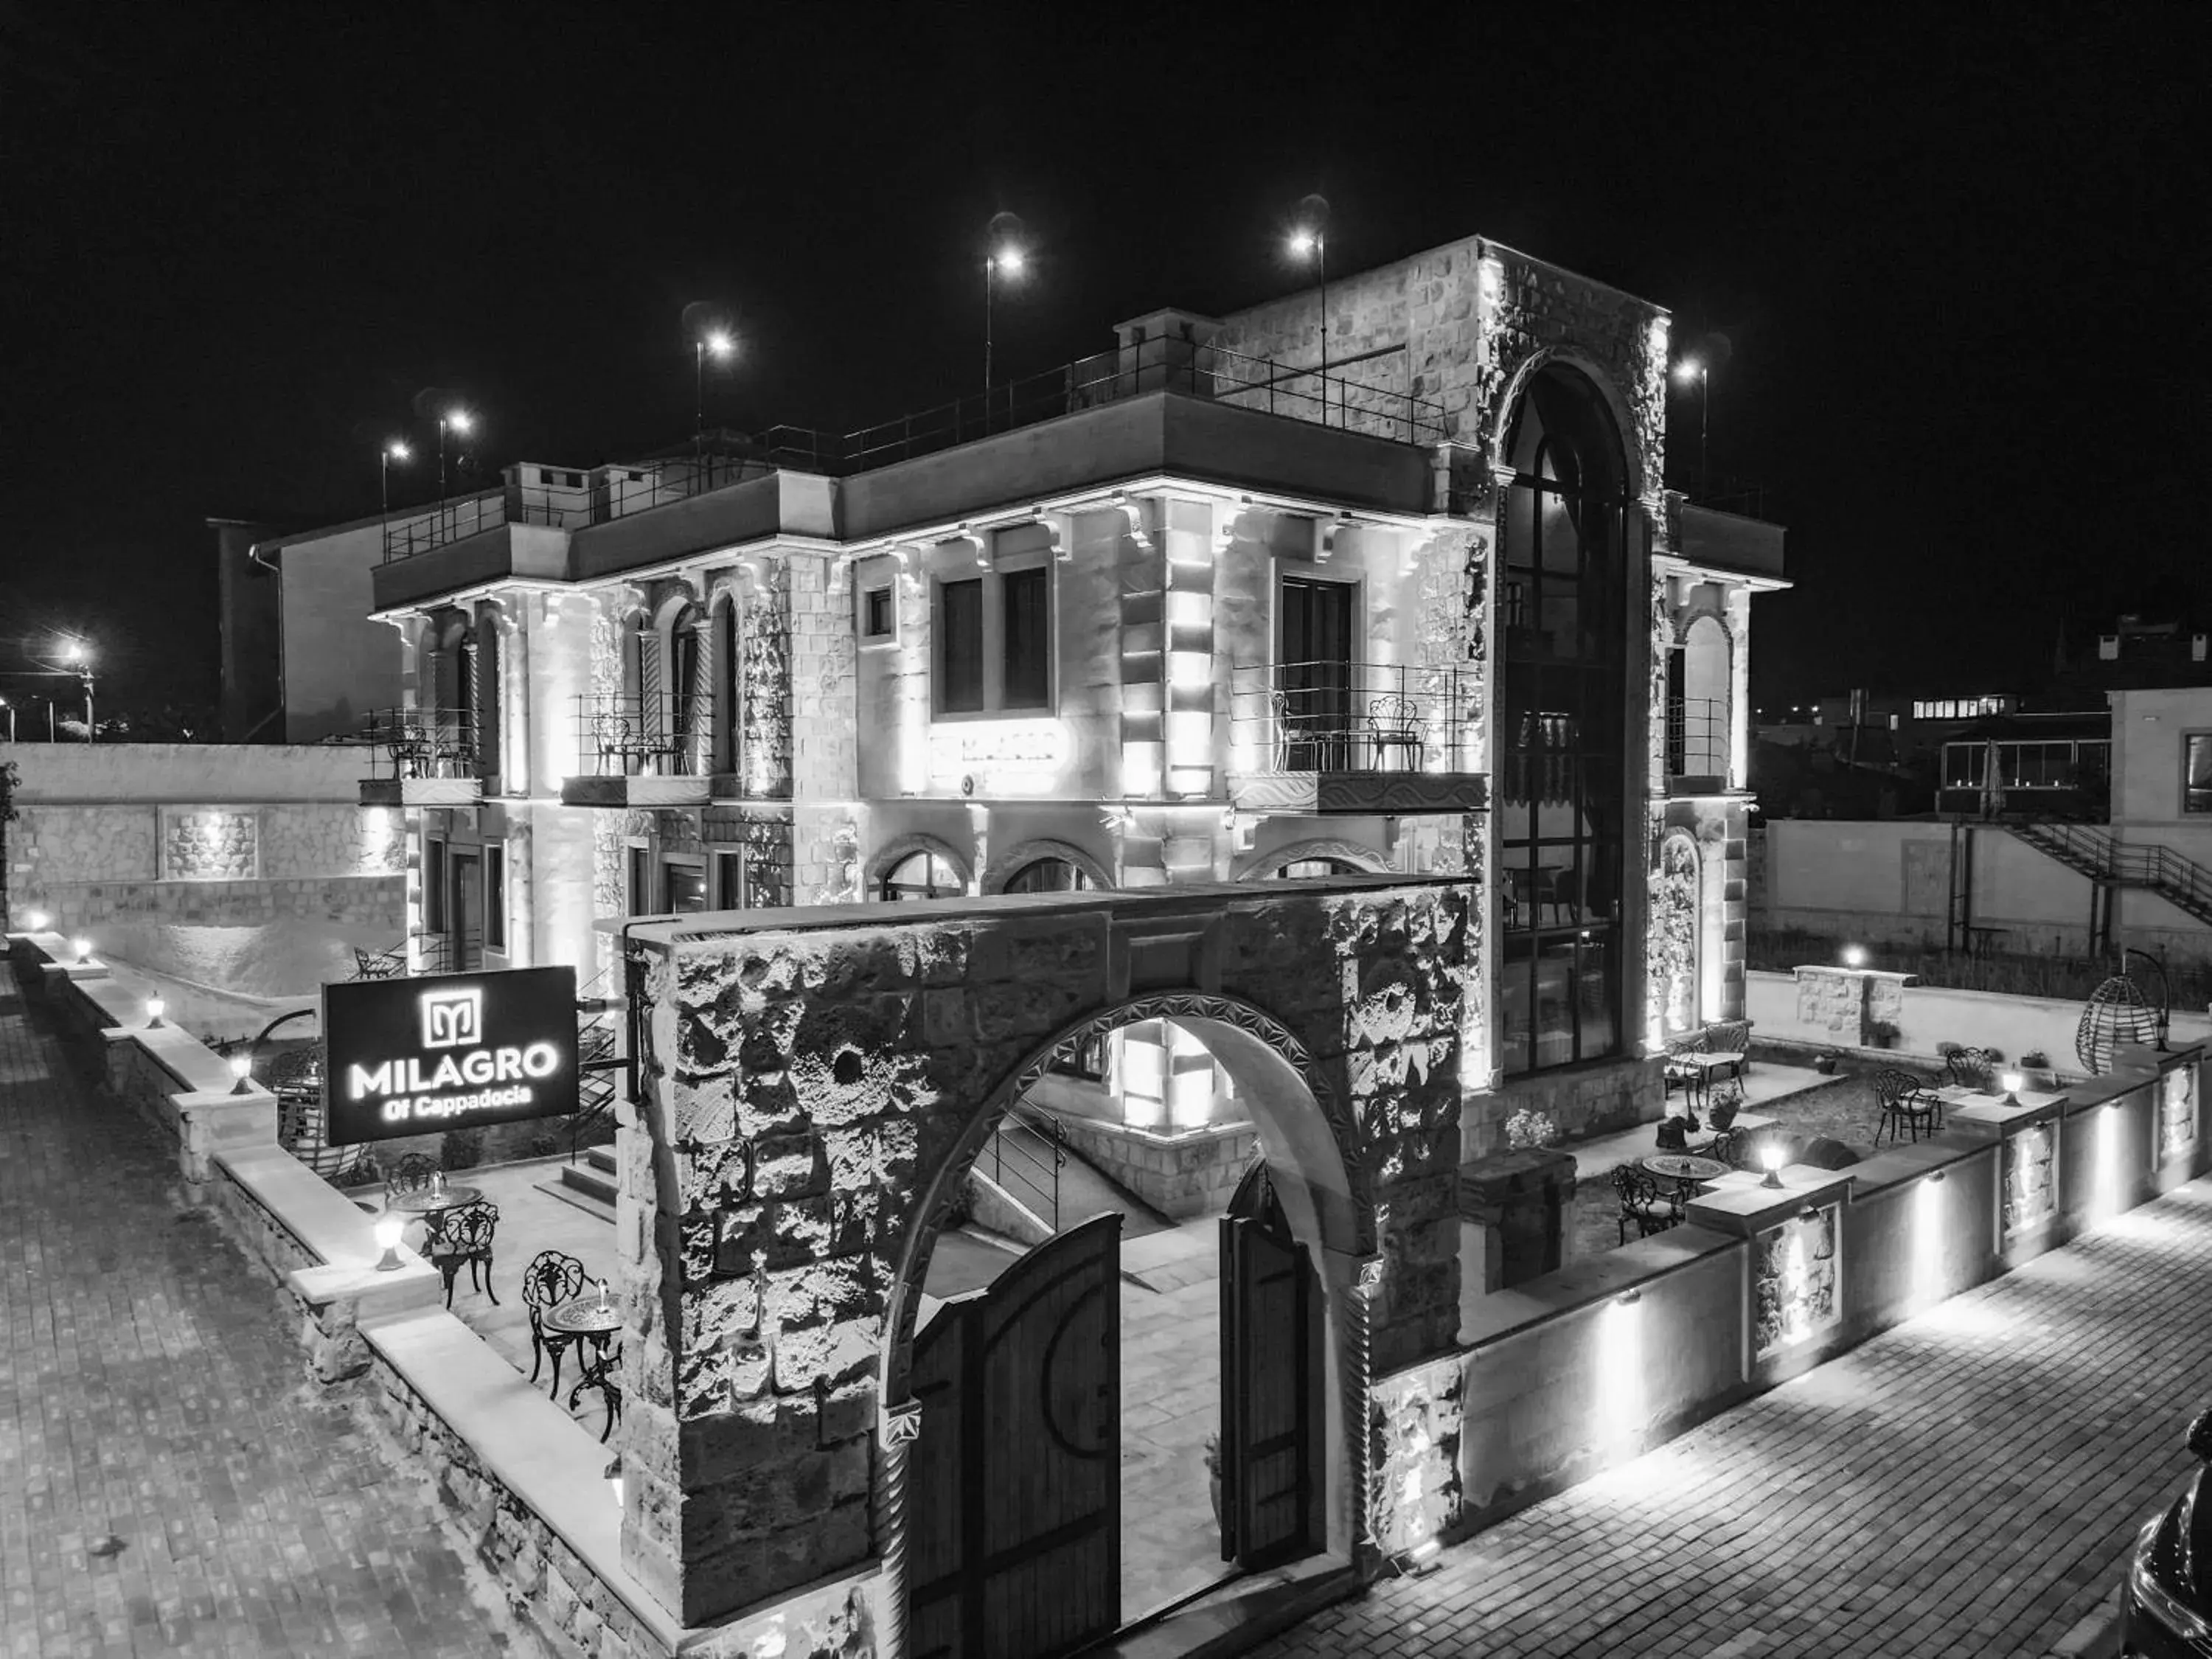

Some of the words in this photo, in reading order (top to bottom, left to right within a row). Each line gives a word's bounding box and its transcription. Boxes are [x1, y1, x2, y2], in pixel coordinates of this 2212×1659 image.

[350, 1043, 558, 1099] MILAGRO
[383, 1099, 410, 1121] Of
[414, 1085, 532, 1117] Cappadocia
